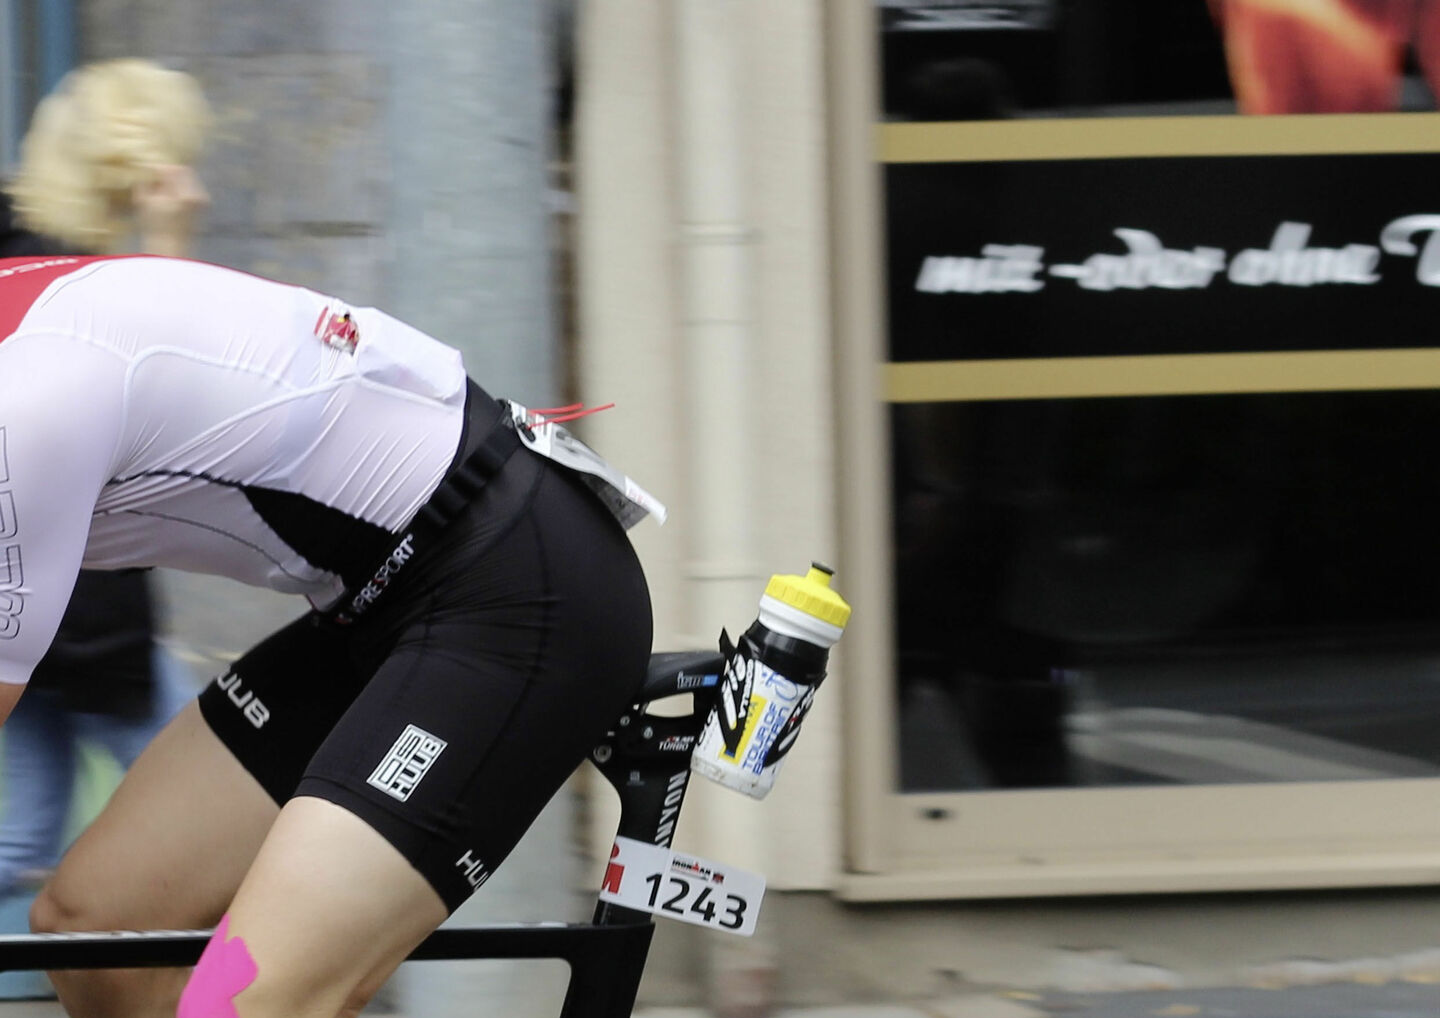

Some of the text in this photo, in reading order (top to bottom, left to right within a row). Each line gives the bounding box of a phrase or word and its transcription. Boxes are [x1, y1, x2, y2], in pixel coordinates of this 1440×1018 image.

[217, 664, 270, 728] UUB
[387, 734, 444, 801] HUUB
[742, 724, 768, 769] TOUR
[654, 769, 688, 848] NYON
[455, 849, 489, 891] HU
[645, 872, 748, 930] 1243
